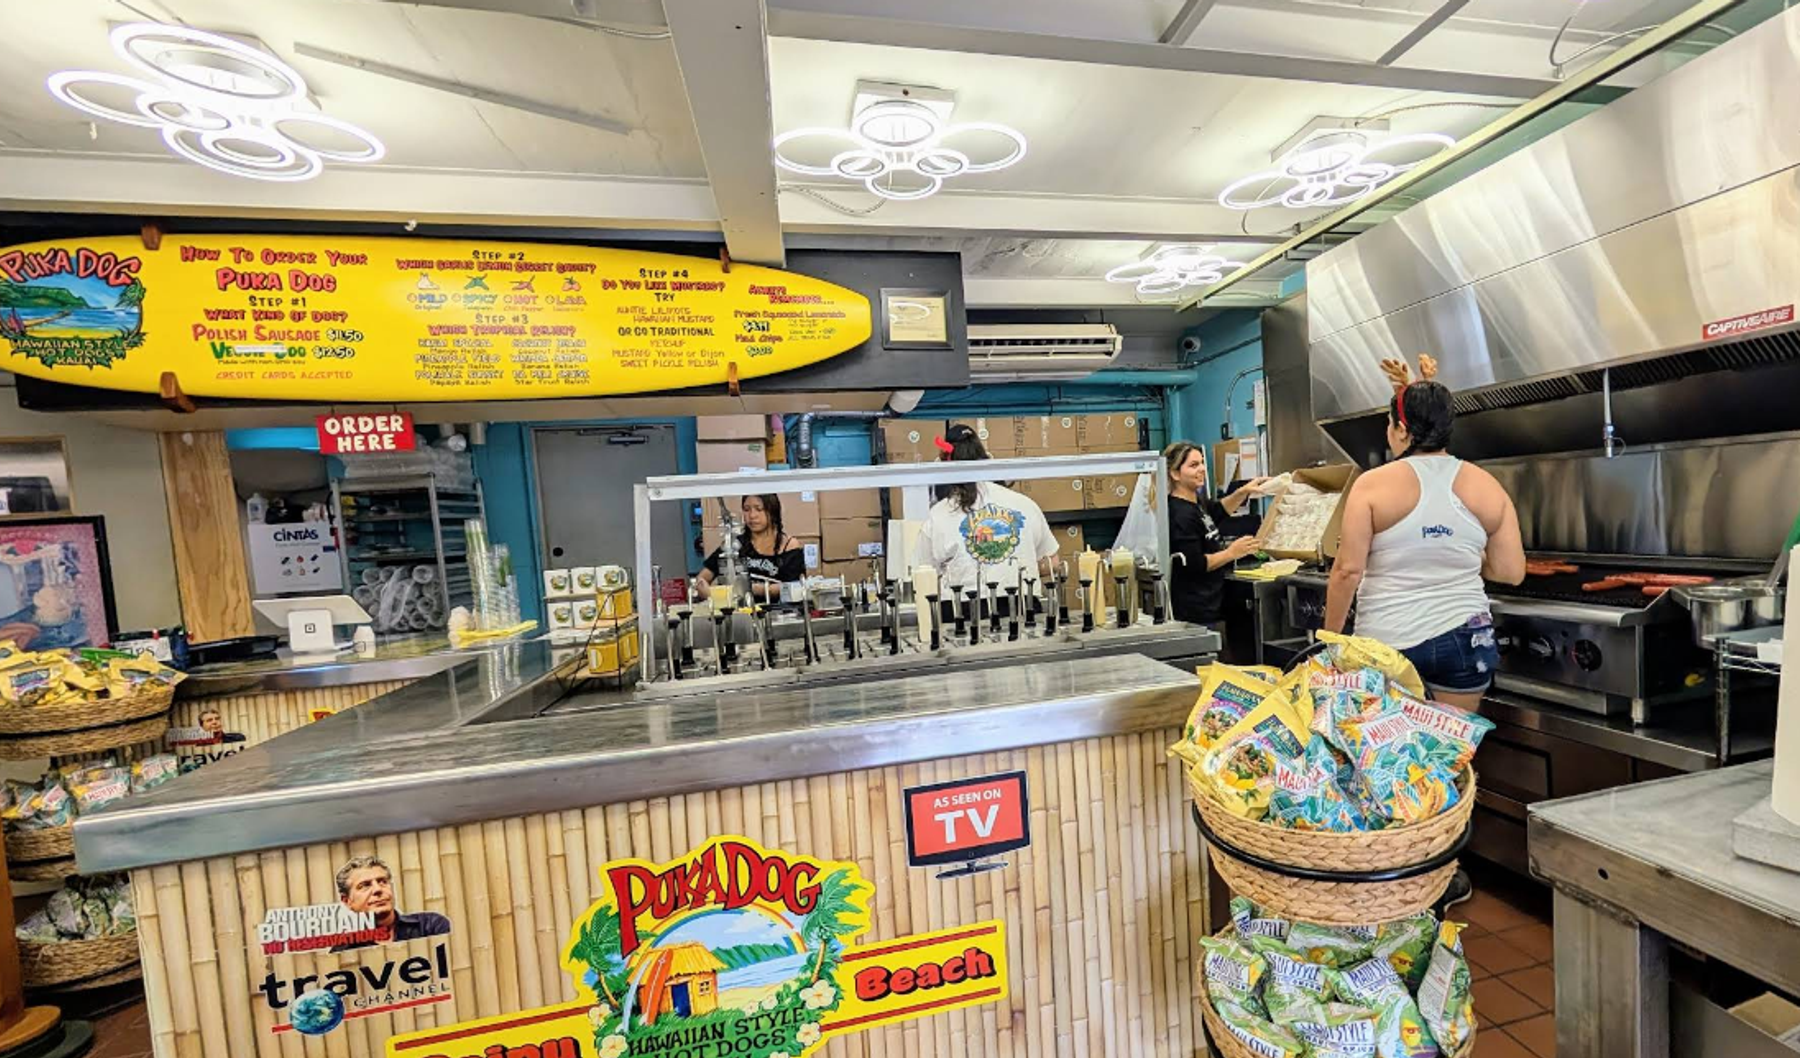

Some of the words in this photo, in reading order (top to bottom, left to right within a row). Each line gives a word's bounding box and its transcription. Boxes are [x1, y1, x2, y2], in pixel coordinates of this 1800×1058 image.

[181, 245, 220, 262] HOW
[230, 247, 254, 264] TO
[261, 248, 317, 265] ORDER
[326, 250, 368, 266] YOUR
[472, 250, 503, 261] STEP
[508, 252, 525, 261] #2
[0, 248, 75, 283] PUKA
[76, 247, 142, 286] DOG
[639, 268, 667, 279] STEP
[673, 270, 689, 279] #4
[216, 267, 283, 291] PUKA
[288, 269, 336, 292] DOG
[249, 296, 283, 306] STEP
[292, 297, 306, 306] #1
[654, 293, 675, 302] TRY
[475, 313, 505, 324] STEP
[512, 314, 529, 324] #3
[192, 323, 247, 342] POLISH
[254, 323, 320, 341] SAUSAGE
[618, 327, 632, 336] OR
[634, 327, 648, 336] GO
[650, 327, 715, 336] TRADITIONAL
[216, 370, 254, 380] CREDIT
[262, 371, 296, 380] CARDS
[300, 370, 354, 380] ACCEPTED
[324, 415, 404, 435] ORDER
[337, 434, 396, 453] HERE
[1402, 700, 1433, 725] MAUI
[933, 796, 949, 808] AS
[952, 792, 981, 807] SEEN
[983, 788, 1002, 802] ON
[934, 803, 1000, 844] TV
[607, 842, 721, 958] PUKA
[717, 841, 823, 916] DOG
[266, 904, 341, 925] ANTHONY
[258, 911, 377, 942] BOURDAIN
[259, 943, 449, 1009] travel
[854, 947, 997, 1001] Beach
[353, 982, 450, 1008] CHANNEL
[629, 1021, 726, 1056] HAWAIIAN
[735, 1007, 805, 1036] STYLE
[653, 1044, 711, 1058] OT
[716, 1028, 787, 1056] DOGS
